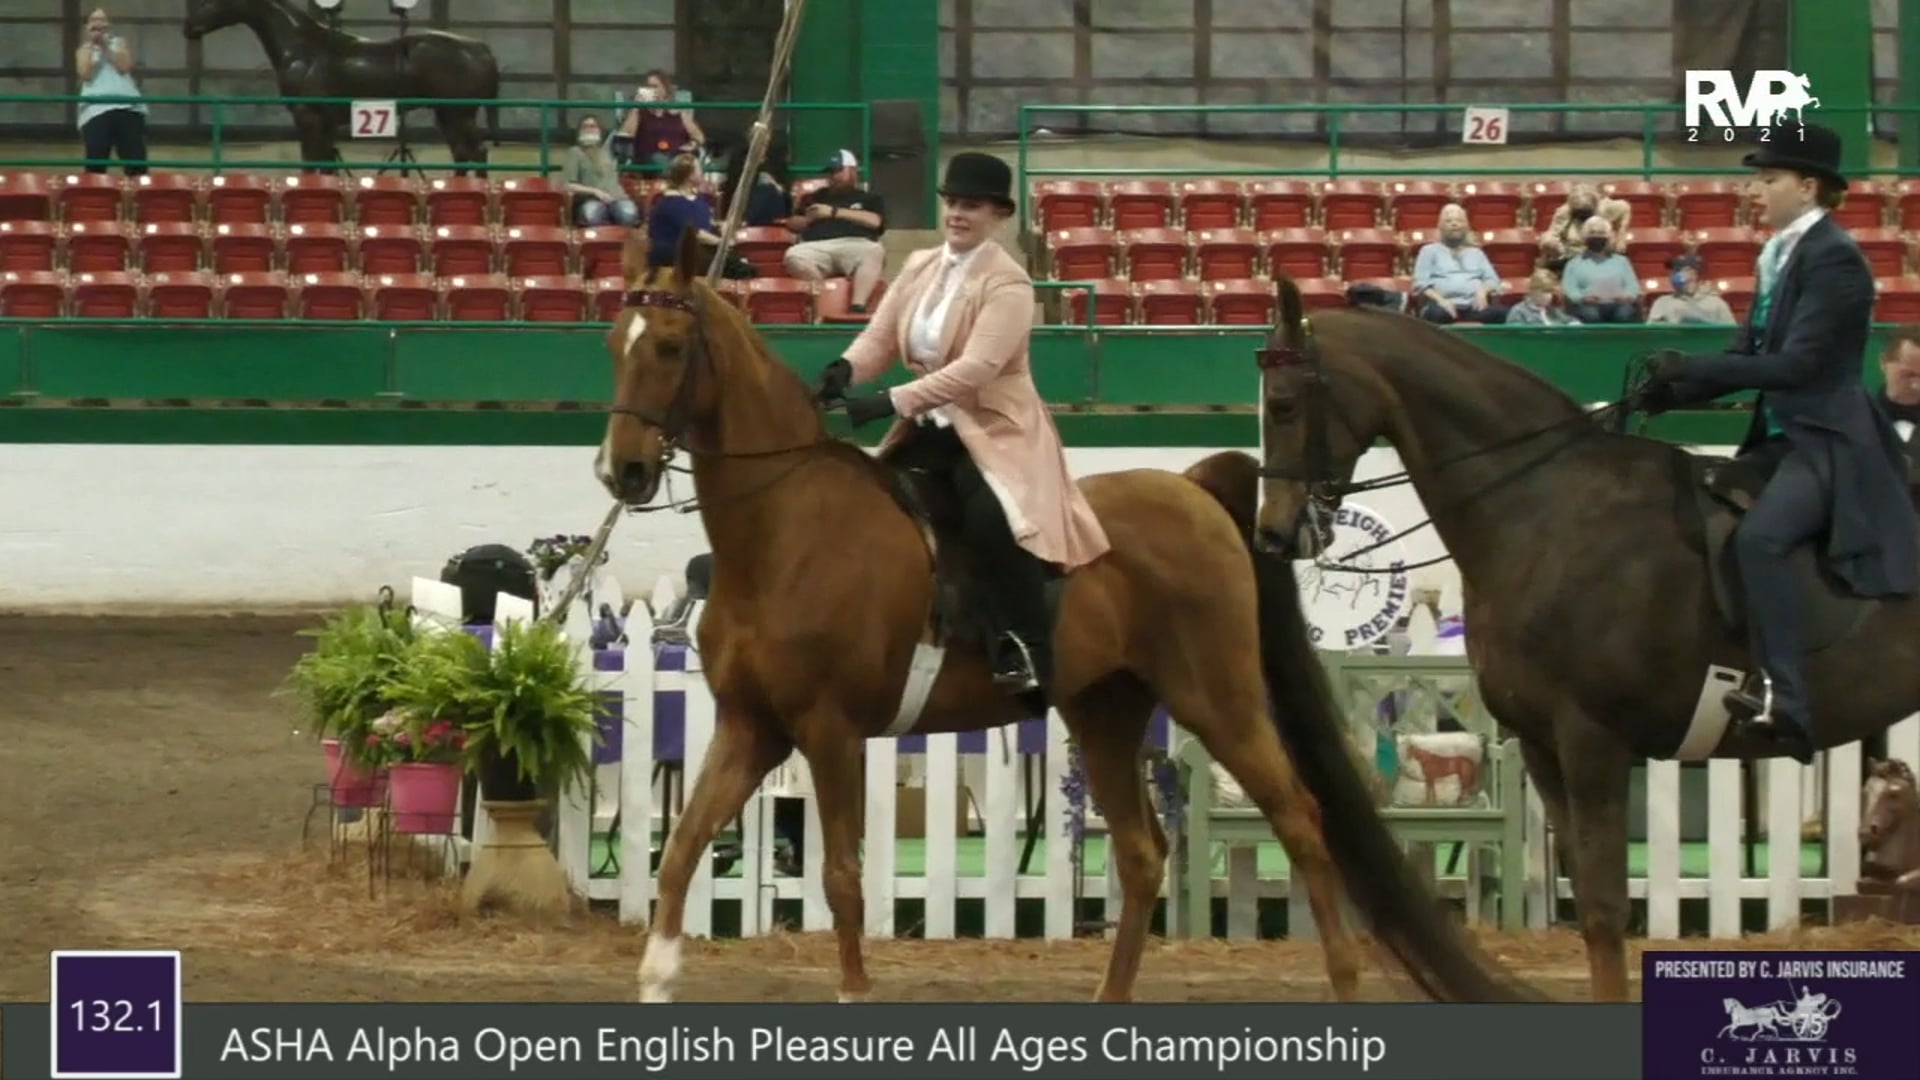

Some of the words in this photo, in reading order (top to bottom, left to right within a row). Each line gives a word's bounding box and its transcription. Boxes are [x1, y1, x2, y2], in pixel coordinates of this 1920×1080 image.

[357, 109, 390, 134] 27
[1468, 116, 1501, 141] 26
[1334, 508, 1391, 543] EIGH
[1344, 560, 1407, 646] PREMIER
